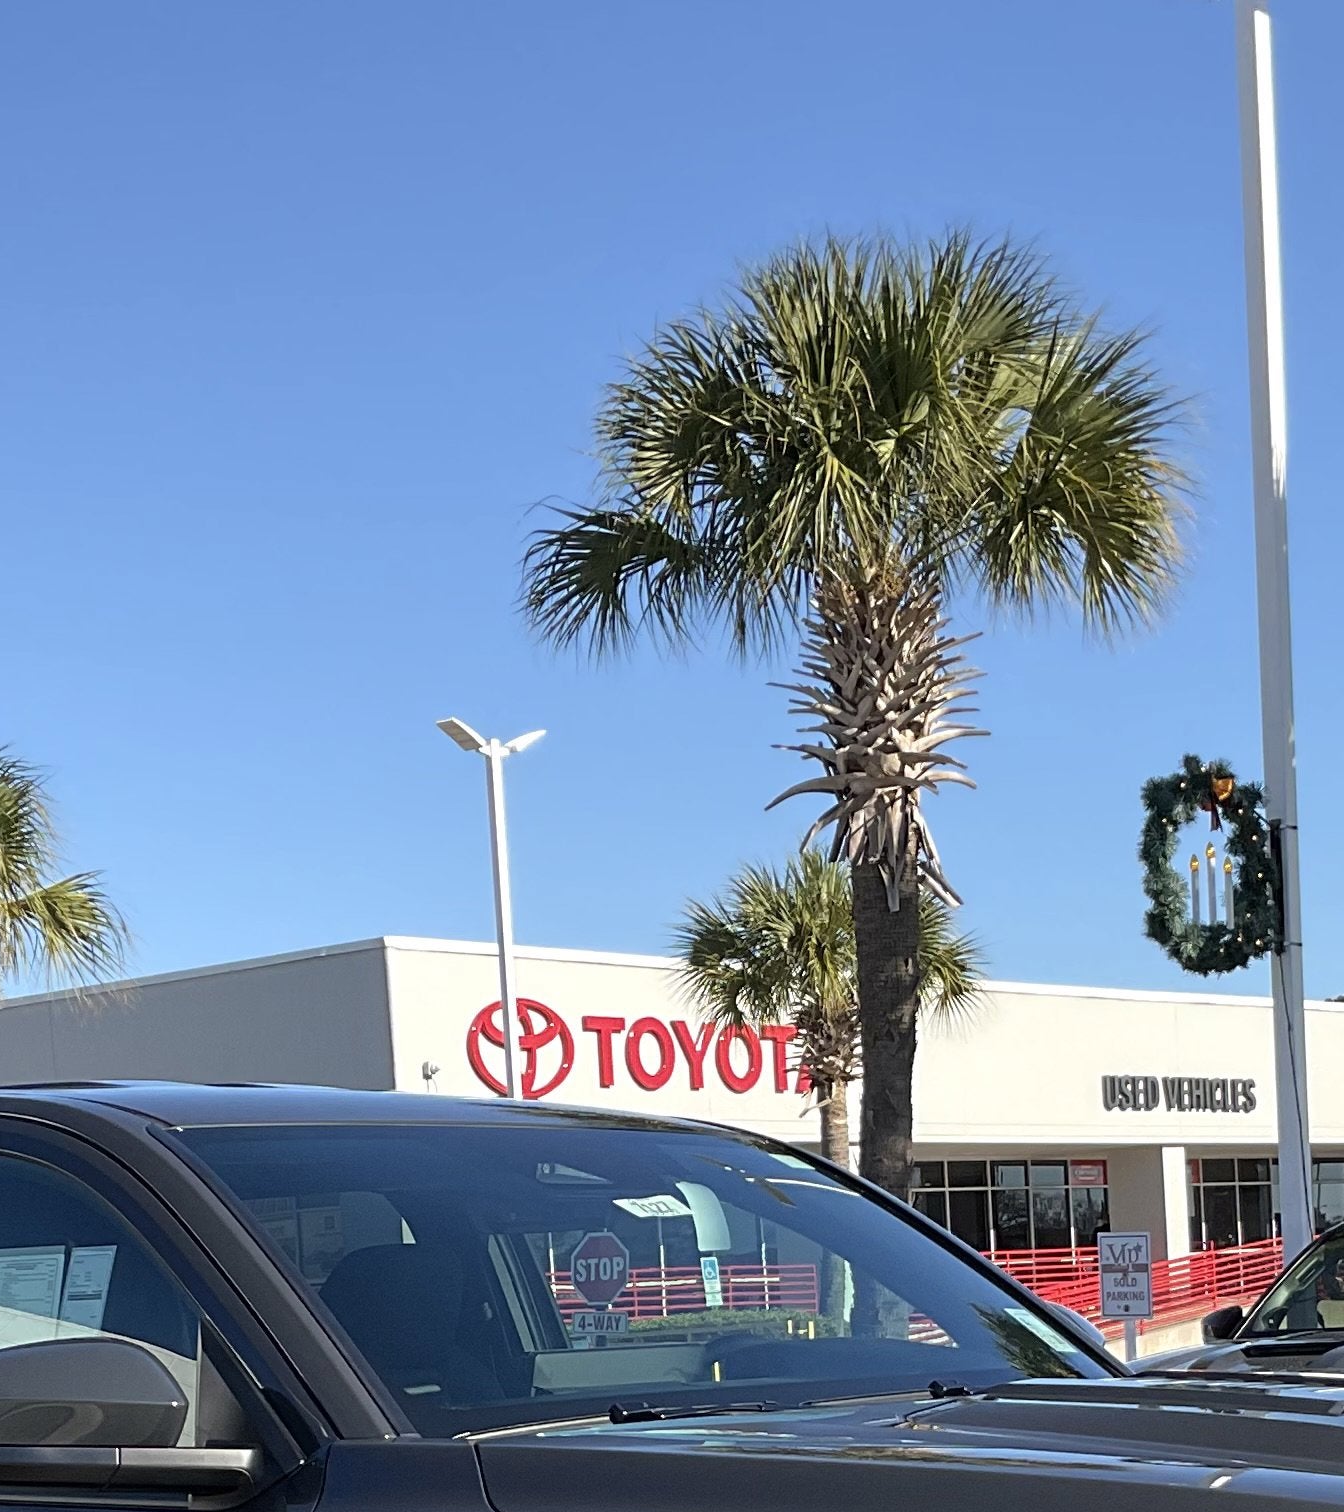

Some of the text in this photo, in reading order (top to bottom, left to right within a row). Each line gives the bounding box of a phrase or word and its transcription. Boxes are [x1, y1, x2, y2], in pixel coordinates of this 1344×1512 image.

[1101, 1074, 1257, 1114] USED VEHICLES
[575, 1257, 625, 1282] STOP
[1113, 1277, 1138, 1288] SOLD
[1106, 1290, 1146, 1301] PARKING
[577, 1315, 622, 1332] 4-WAY
